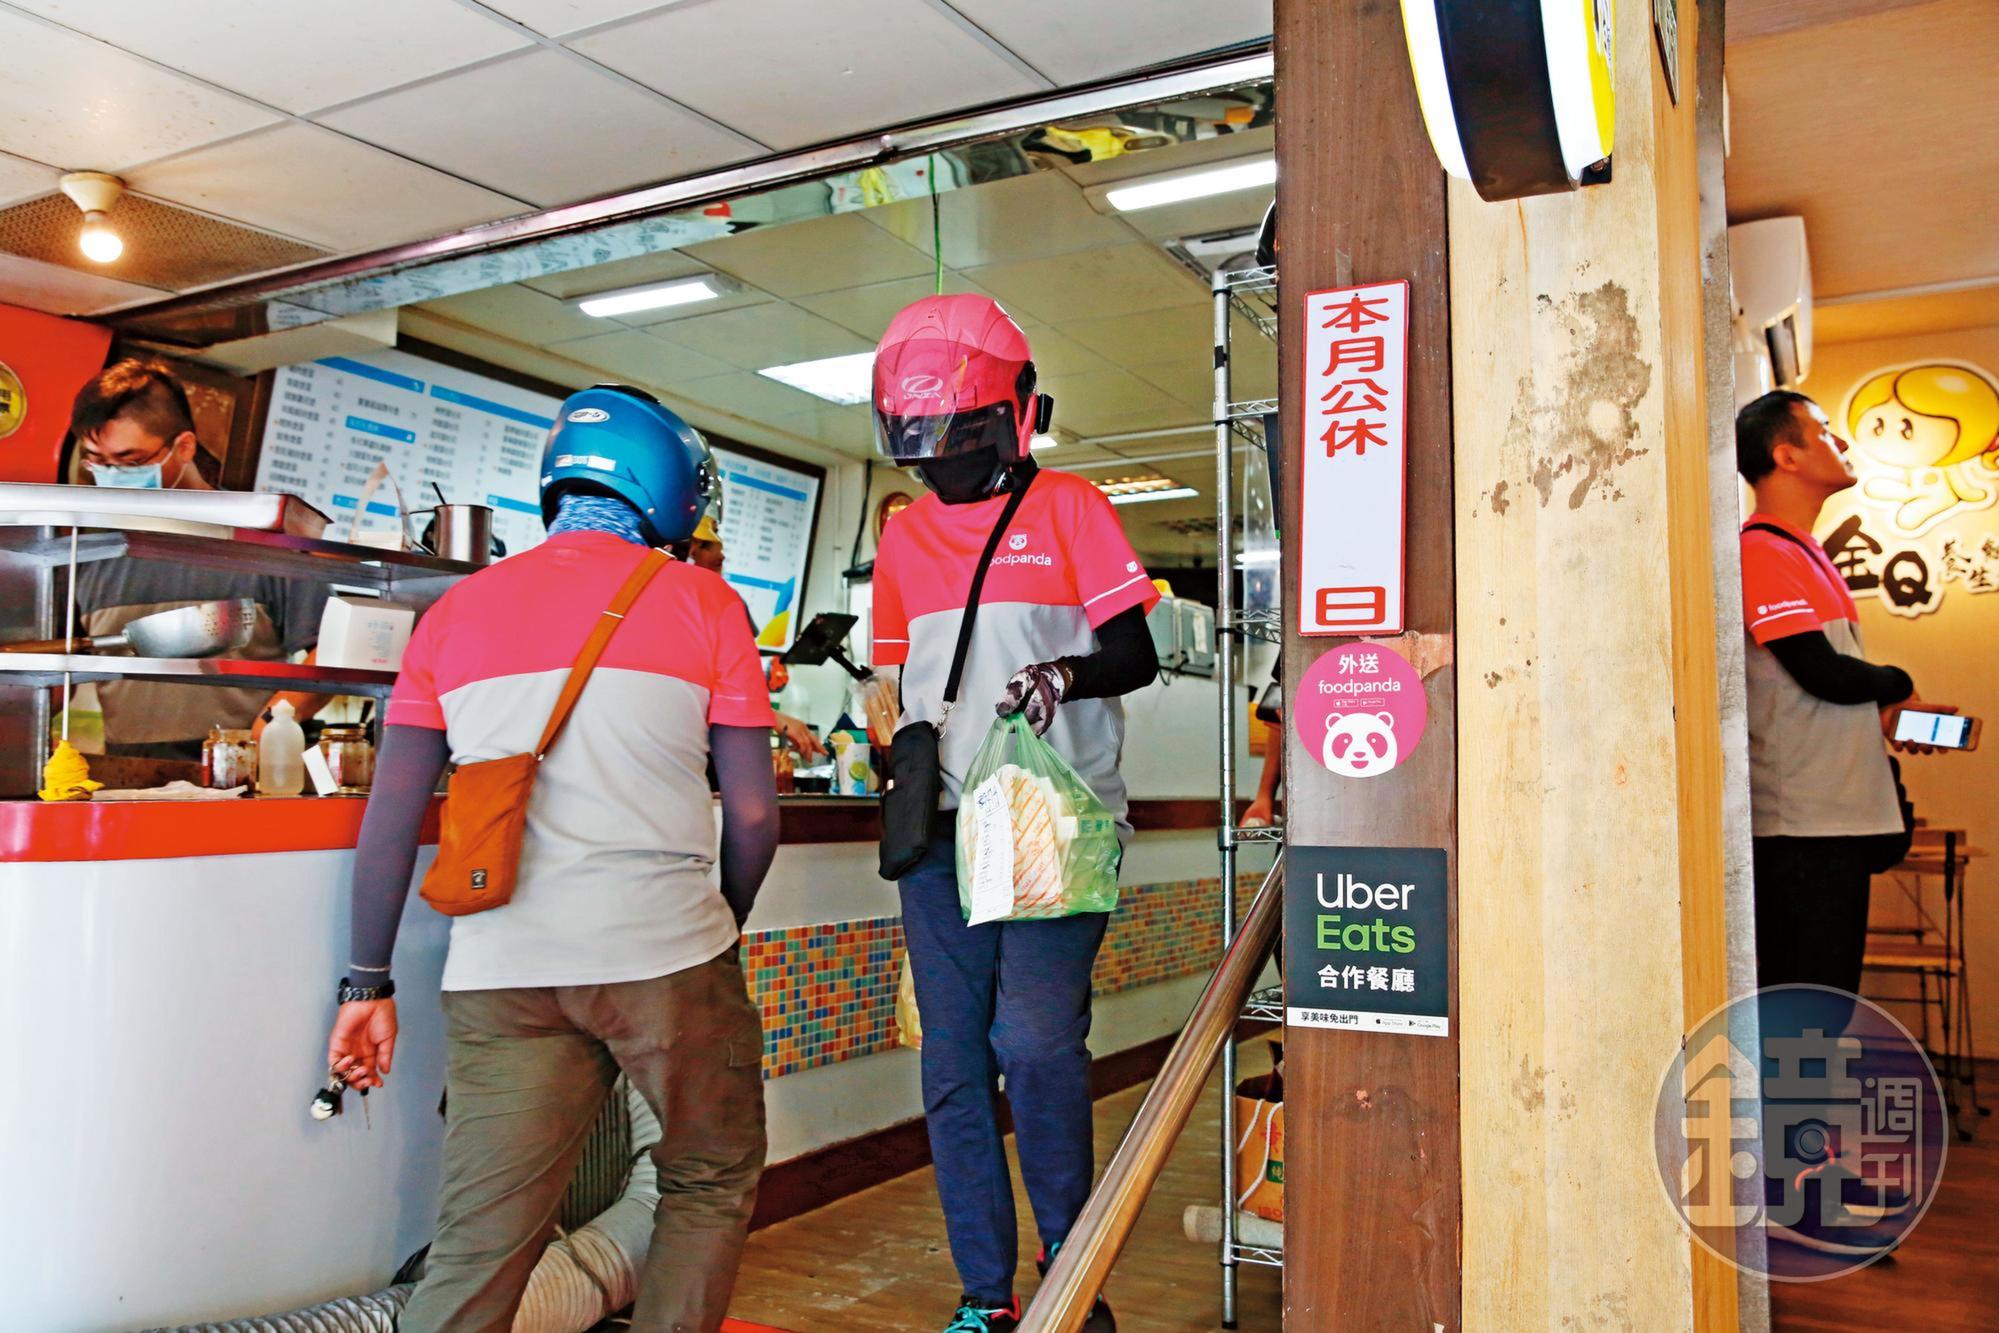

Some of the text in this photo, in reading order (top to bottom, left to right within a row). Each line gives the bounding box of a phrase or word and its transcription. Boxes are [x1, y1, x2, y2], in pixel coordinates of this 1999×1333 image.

[1315, 297, 1390, 626] 本月公休 日
[1338, 653, 1379, 675] 外送
[1318, 677, 1401, 696] foodpanda
[1317, 873, 1416, 911] Uber
[1317, 914, 1416, 953] Eats
[1317, 964, 1415, 993] 合作餐廳
[1301, 1011, 1359, 1025] 享美味免出門
